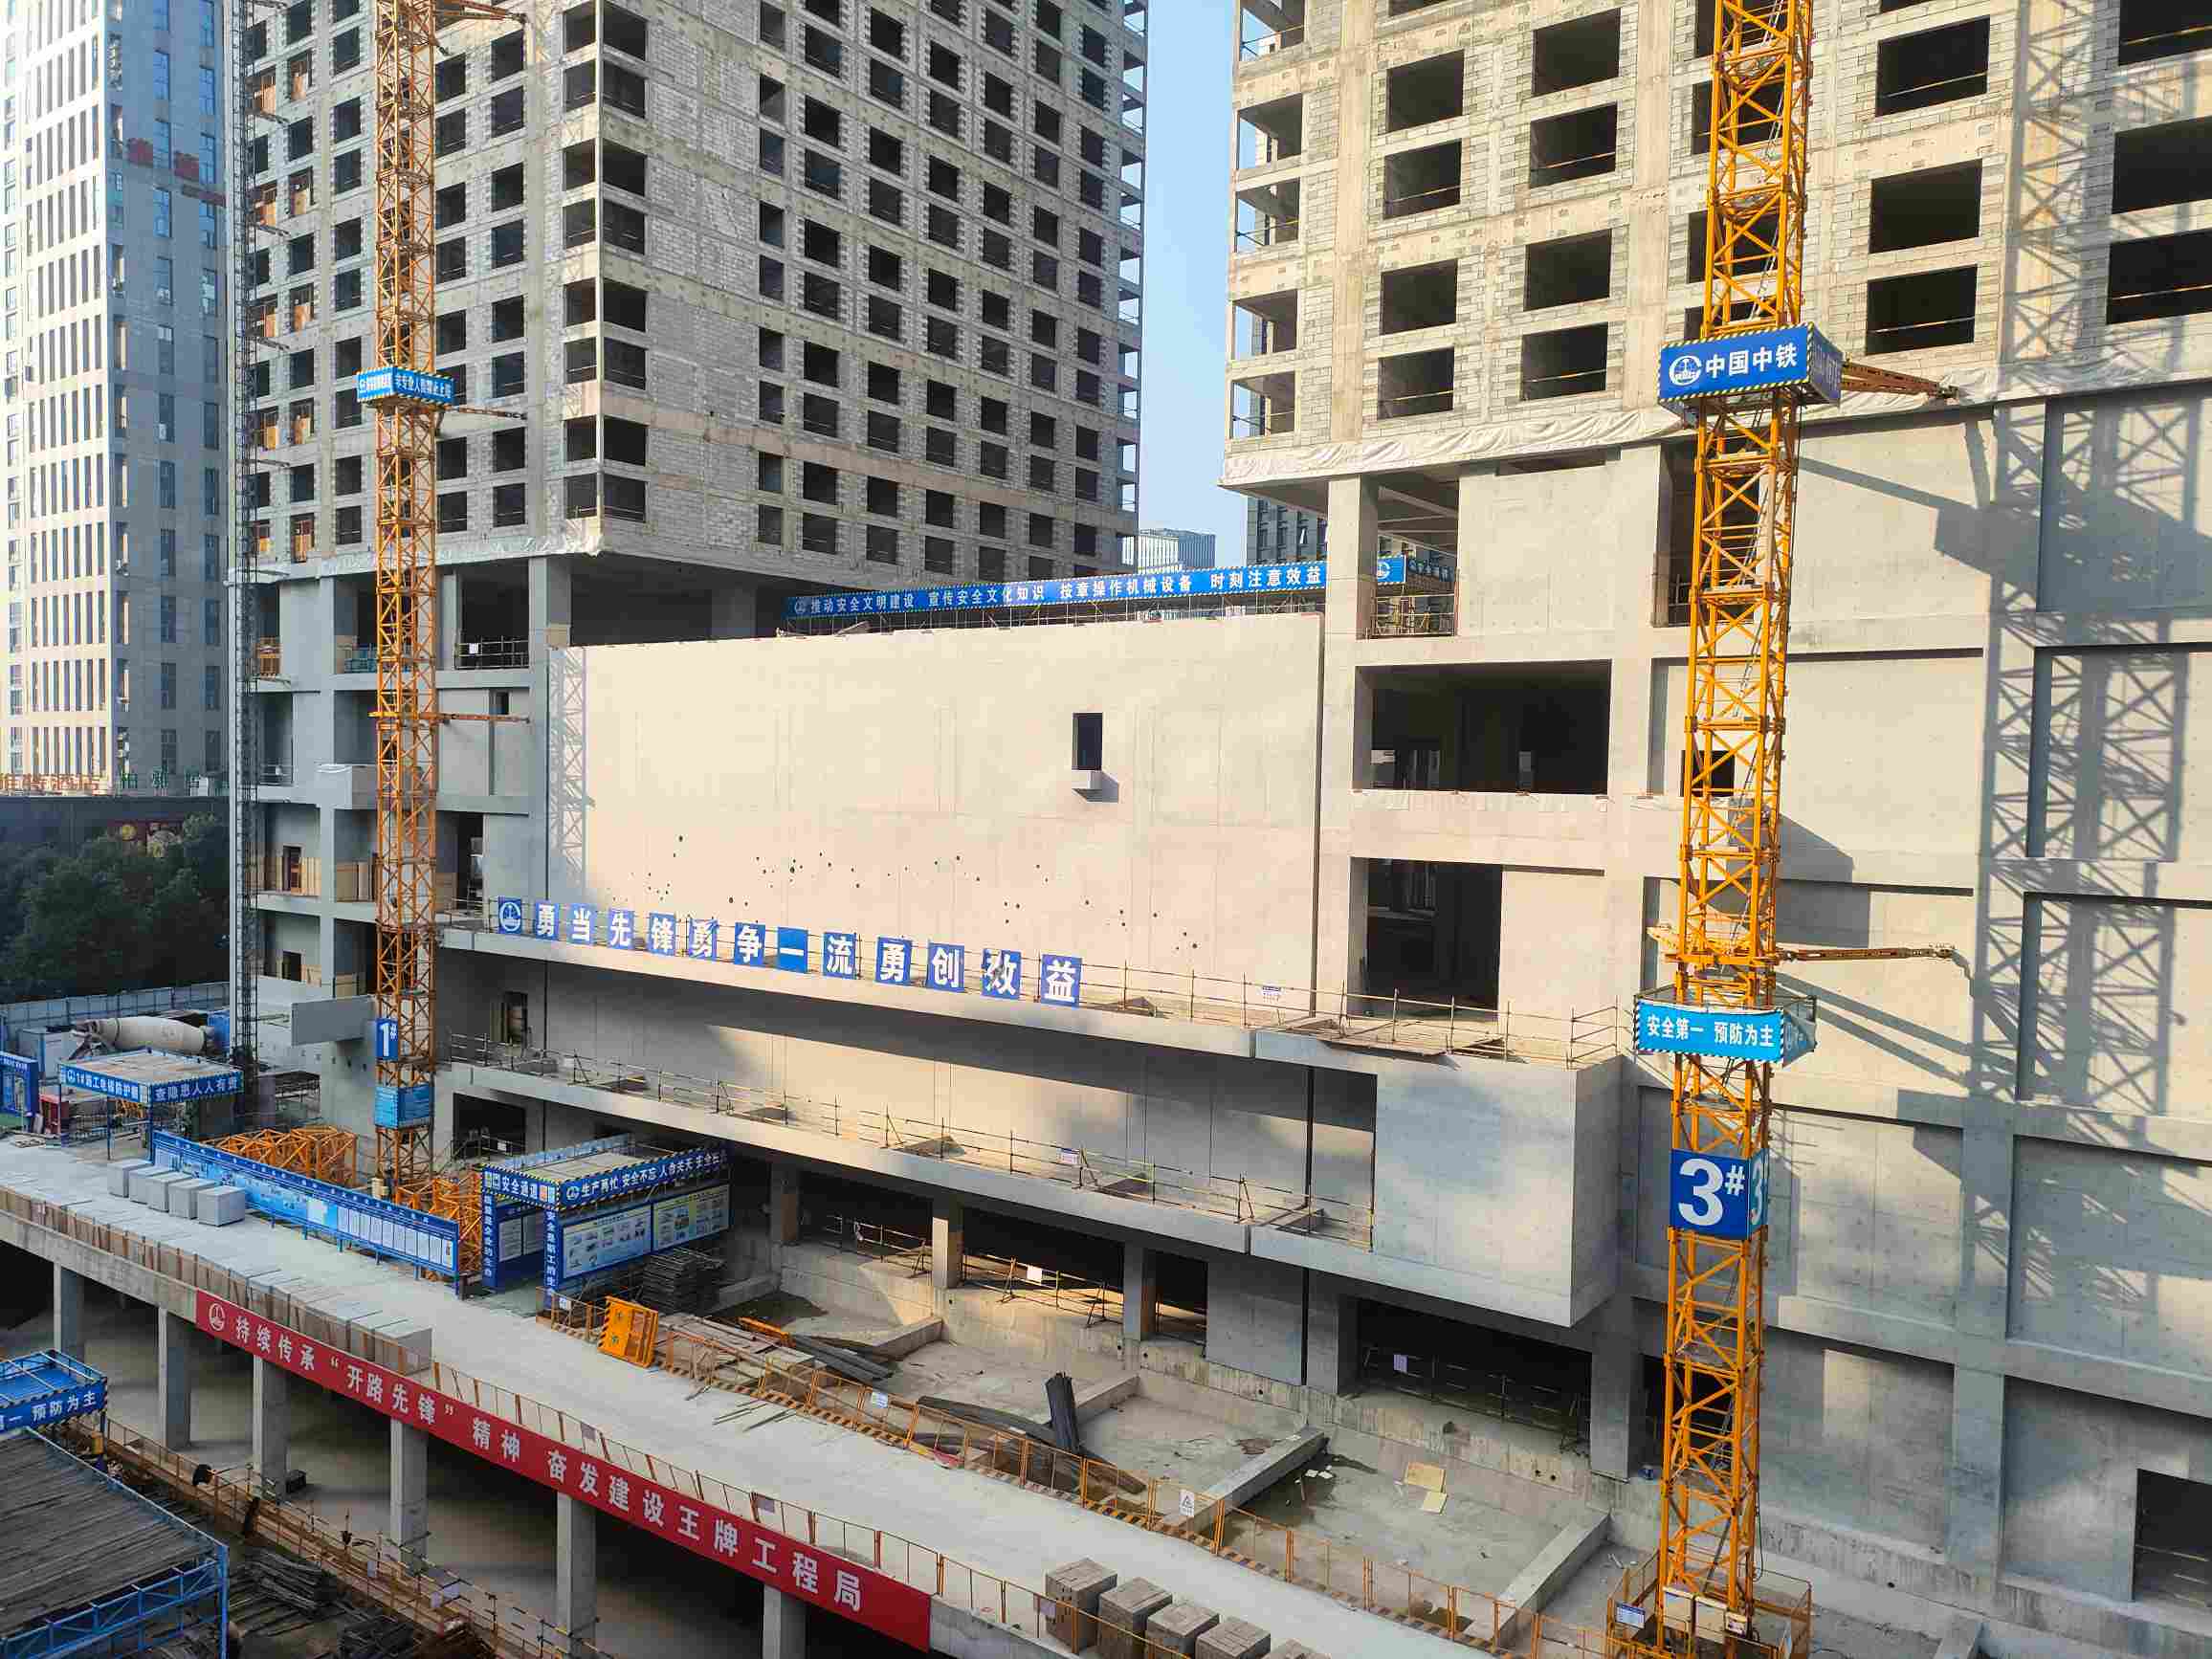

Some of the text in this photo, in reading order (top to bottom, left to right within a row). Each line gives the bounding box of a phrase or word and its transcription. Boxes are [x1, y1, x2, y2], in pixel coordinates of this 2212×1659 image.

[1705, 344, 1798, 379] 中国中铁
[929, 585, 1045, 608] 宣传安全文化知识
[1060, 575, 1192, 600] 按章操作机械设备
[1210, 566, 1322, 587] 时刻注意效益
[1647, 1015, 1703, 1040] 安全第一
[1714, 1021, 1775, 1048] 预防为主
[1677, 1158, 1746, 1227] 3#
[32, 1391, 97, 1422] 预防为主
[547, 1449, 862, 1612] 奋发建设王牌工程局
